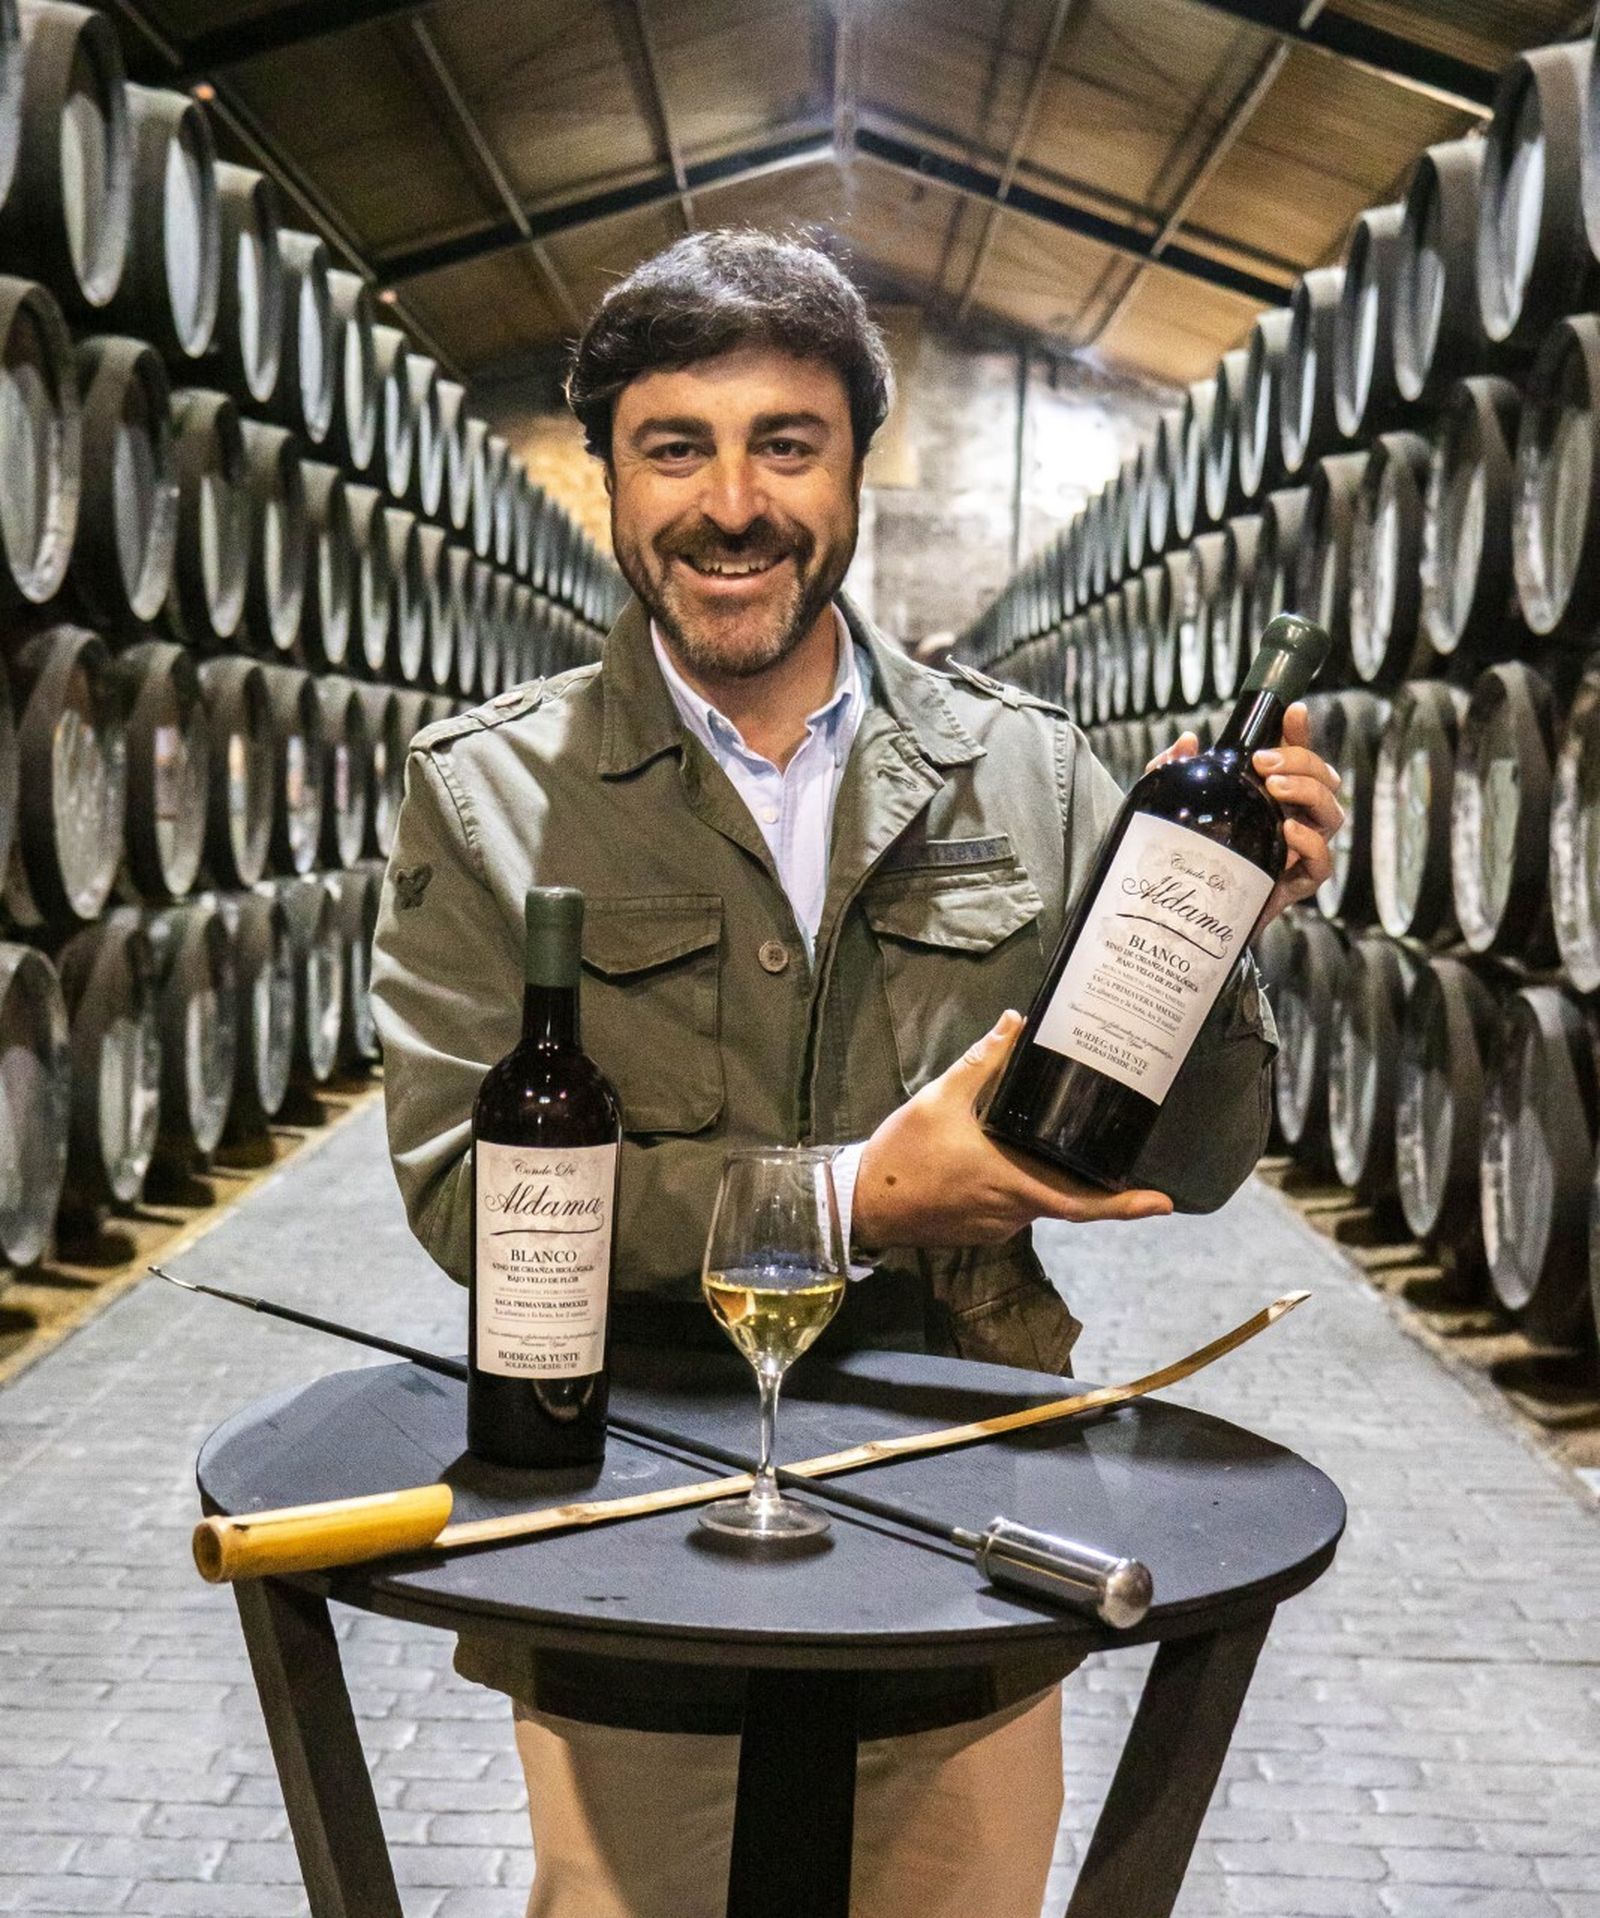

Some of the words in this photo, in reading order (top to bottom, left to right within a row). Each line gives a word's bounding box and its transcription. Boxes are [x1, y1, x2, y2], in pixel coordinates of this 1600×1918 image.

[1170, 854, 1205, 880] Conde
[1206, 874, 1227, 892] De
[1121, 876, 1234, 944] Aldama
[1105, 940, 1123, 953] VINO
[1123, 950, 1134, 958] DE
[1134, 955, 1165, 973] CRIANZA
[1128, 935, 1192, 974] BLANCO
[1116, 957, 1134, 969] BAJO
[1134, 966, 1155, 979] VELO
[1154, 976, 1165, 985] DE
[1164, 981, 1183, 994] FLOR
[1111, 983, 1154, 1008] PRIMAVERA
[1072, 1027, 1119, 1055] BODEGAS
[1120, 1050, 1150, 1070] YUSTE
[512, 1159, 551, 1176] Conde
[555, 1161, 577, 1176] De
[485, 1181, 605, 1224] Aldama
[492, 1263, 508, 1272] VINO
[510, 1264, 520, 1272] DE
[521, 1265, 554, 1273] CRIANZA
[511, 1249, 577, 1263] BLANCO
[507, 1275, 525, 1283] BAJO
[527, 1276, 547, 1284] VELO
[548, 1276, 558, 1284] DE
[495, 1298, 512, 1307] SACA
[513, 1299, 557, 1309] PRIMAVERA
[498, 1350, 546, 1362] BODEGAS
[548, 1351, 580, 1362] YUSTE
[505, 1361, 536, 1369] SOLERAS
